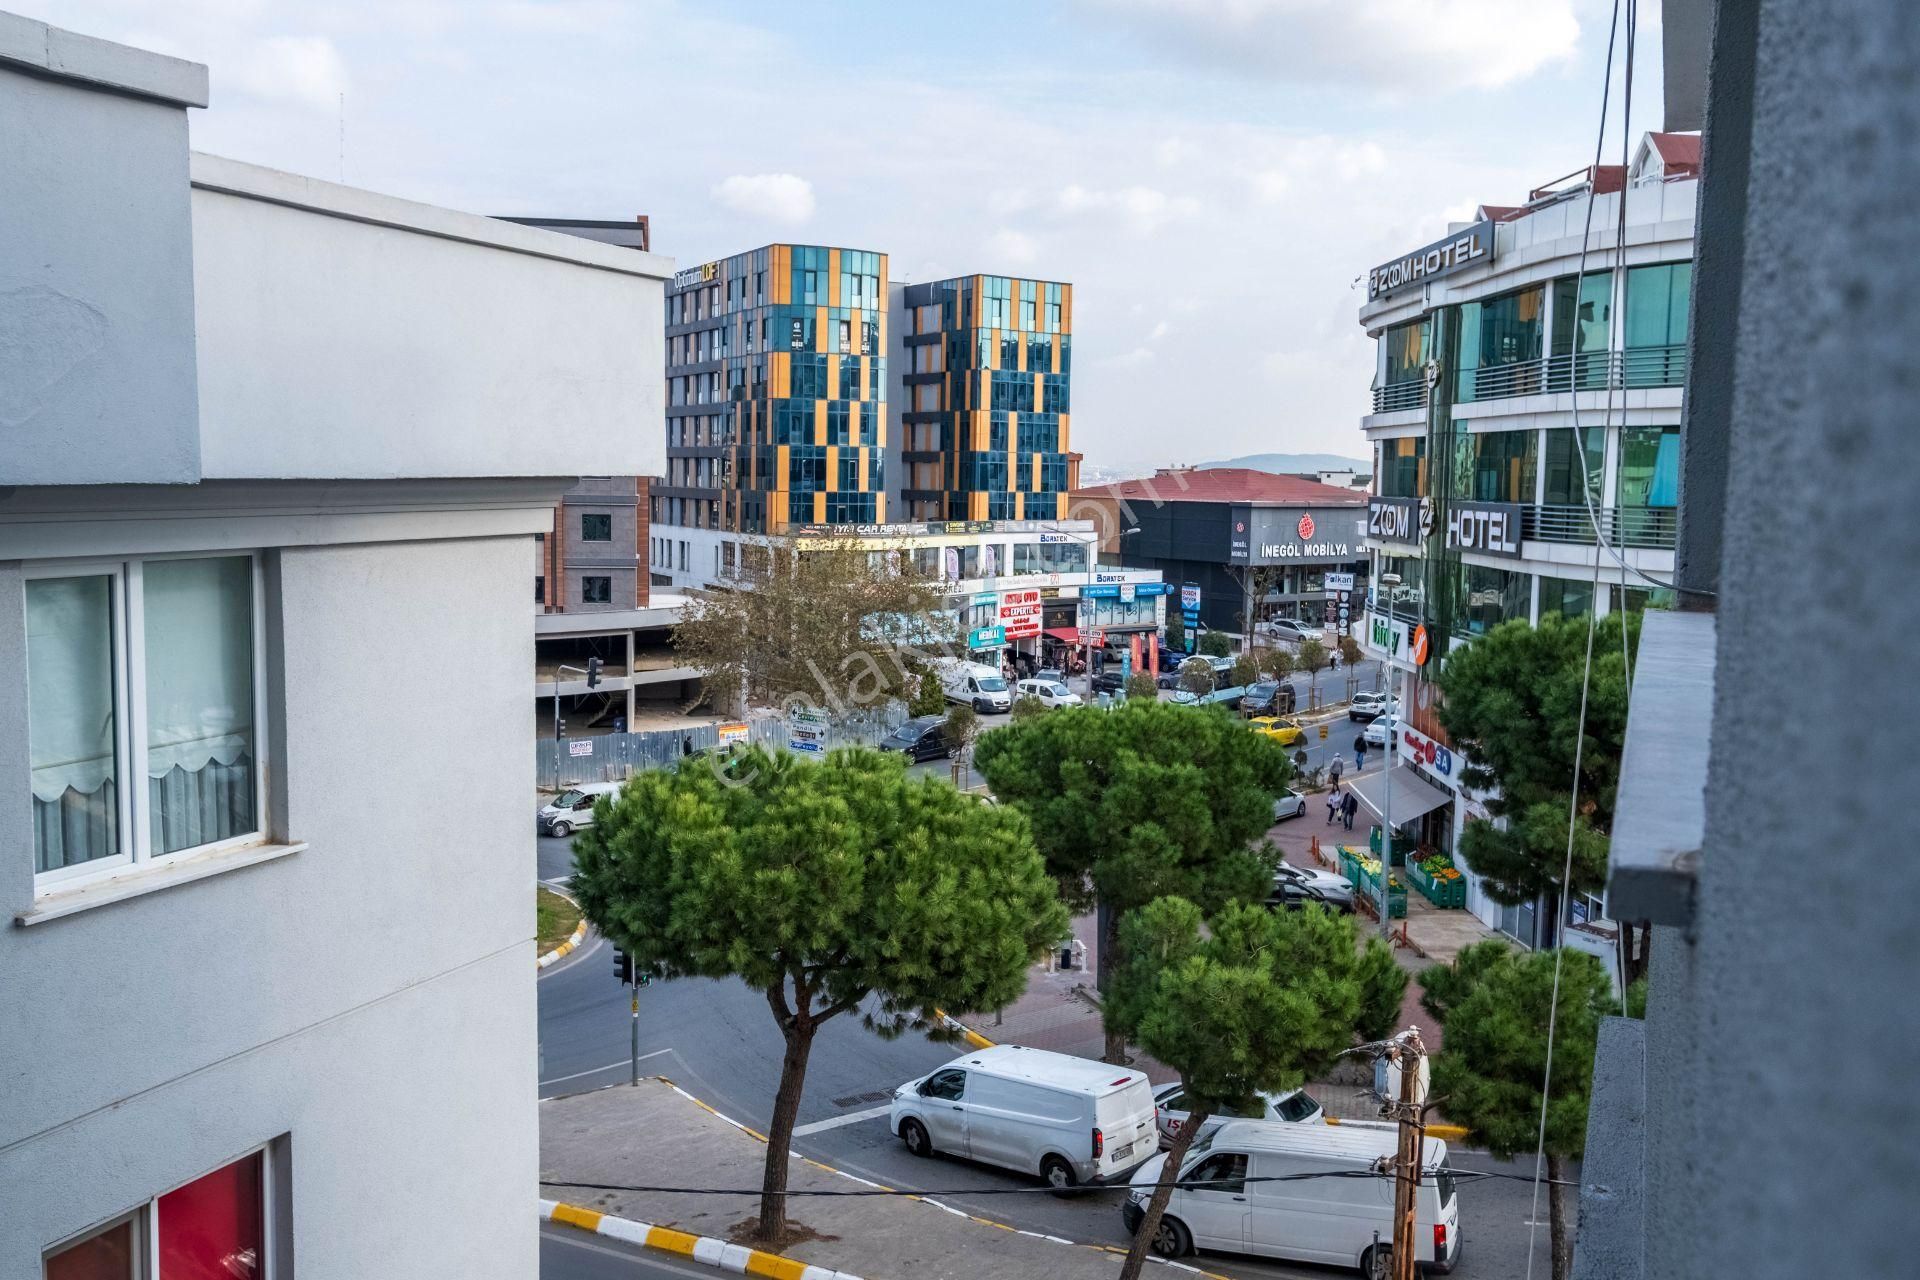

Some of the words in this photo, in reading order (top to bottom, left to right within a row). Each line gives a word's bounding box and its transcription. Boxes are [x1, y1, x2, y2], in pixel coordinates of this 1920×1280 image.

[702, 261, 721, 282] LOFT
[1379, 258, 1411, 292] ZOOM
[1414, 234, 1483, 279] HOTEL
[856, 525, 878, 533] CAR
[1370, 503, 1409, 539] ZOOM
[1446, 509, 1516, 552] HOTEL
[1261, 542, 1300, 558] İNEGÖL
[1304, 541, 1348, 557] MOBİLYA
[1373, 618, 1400, 656] biry
